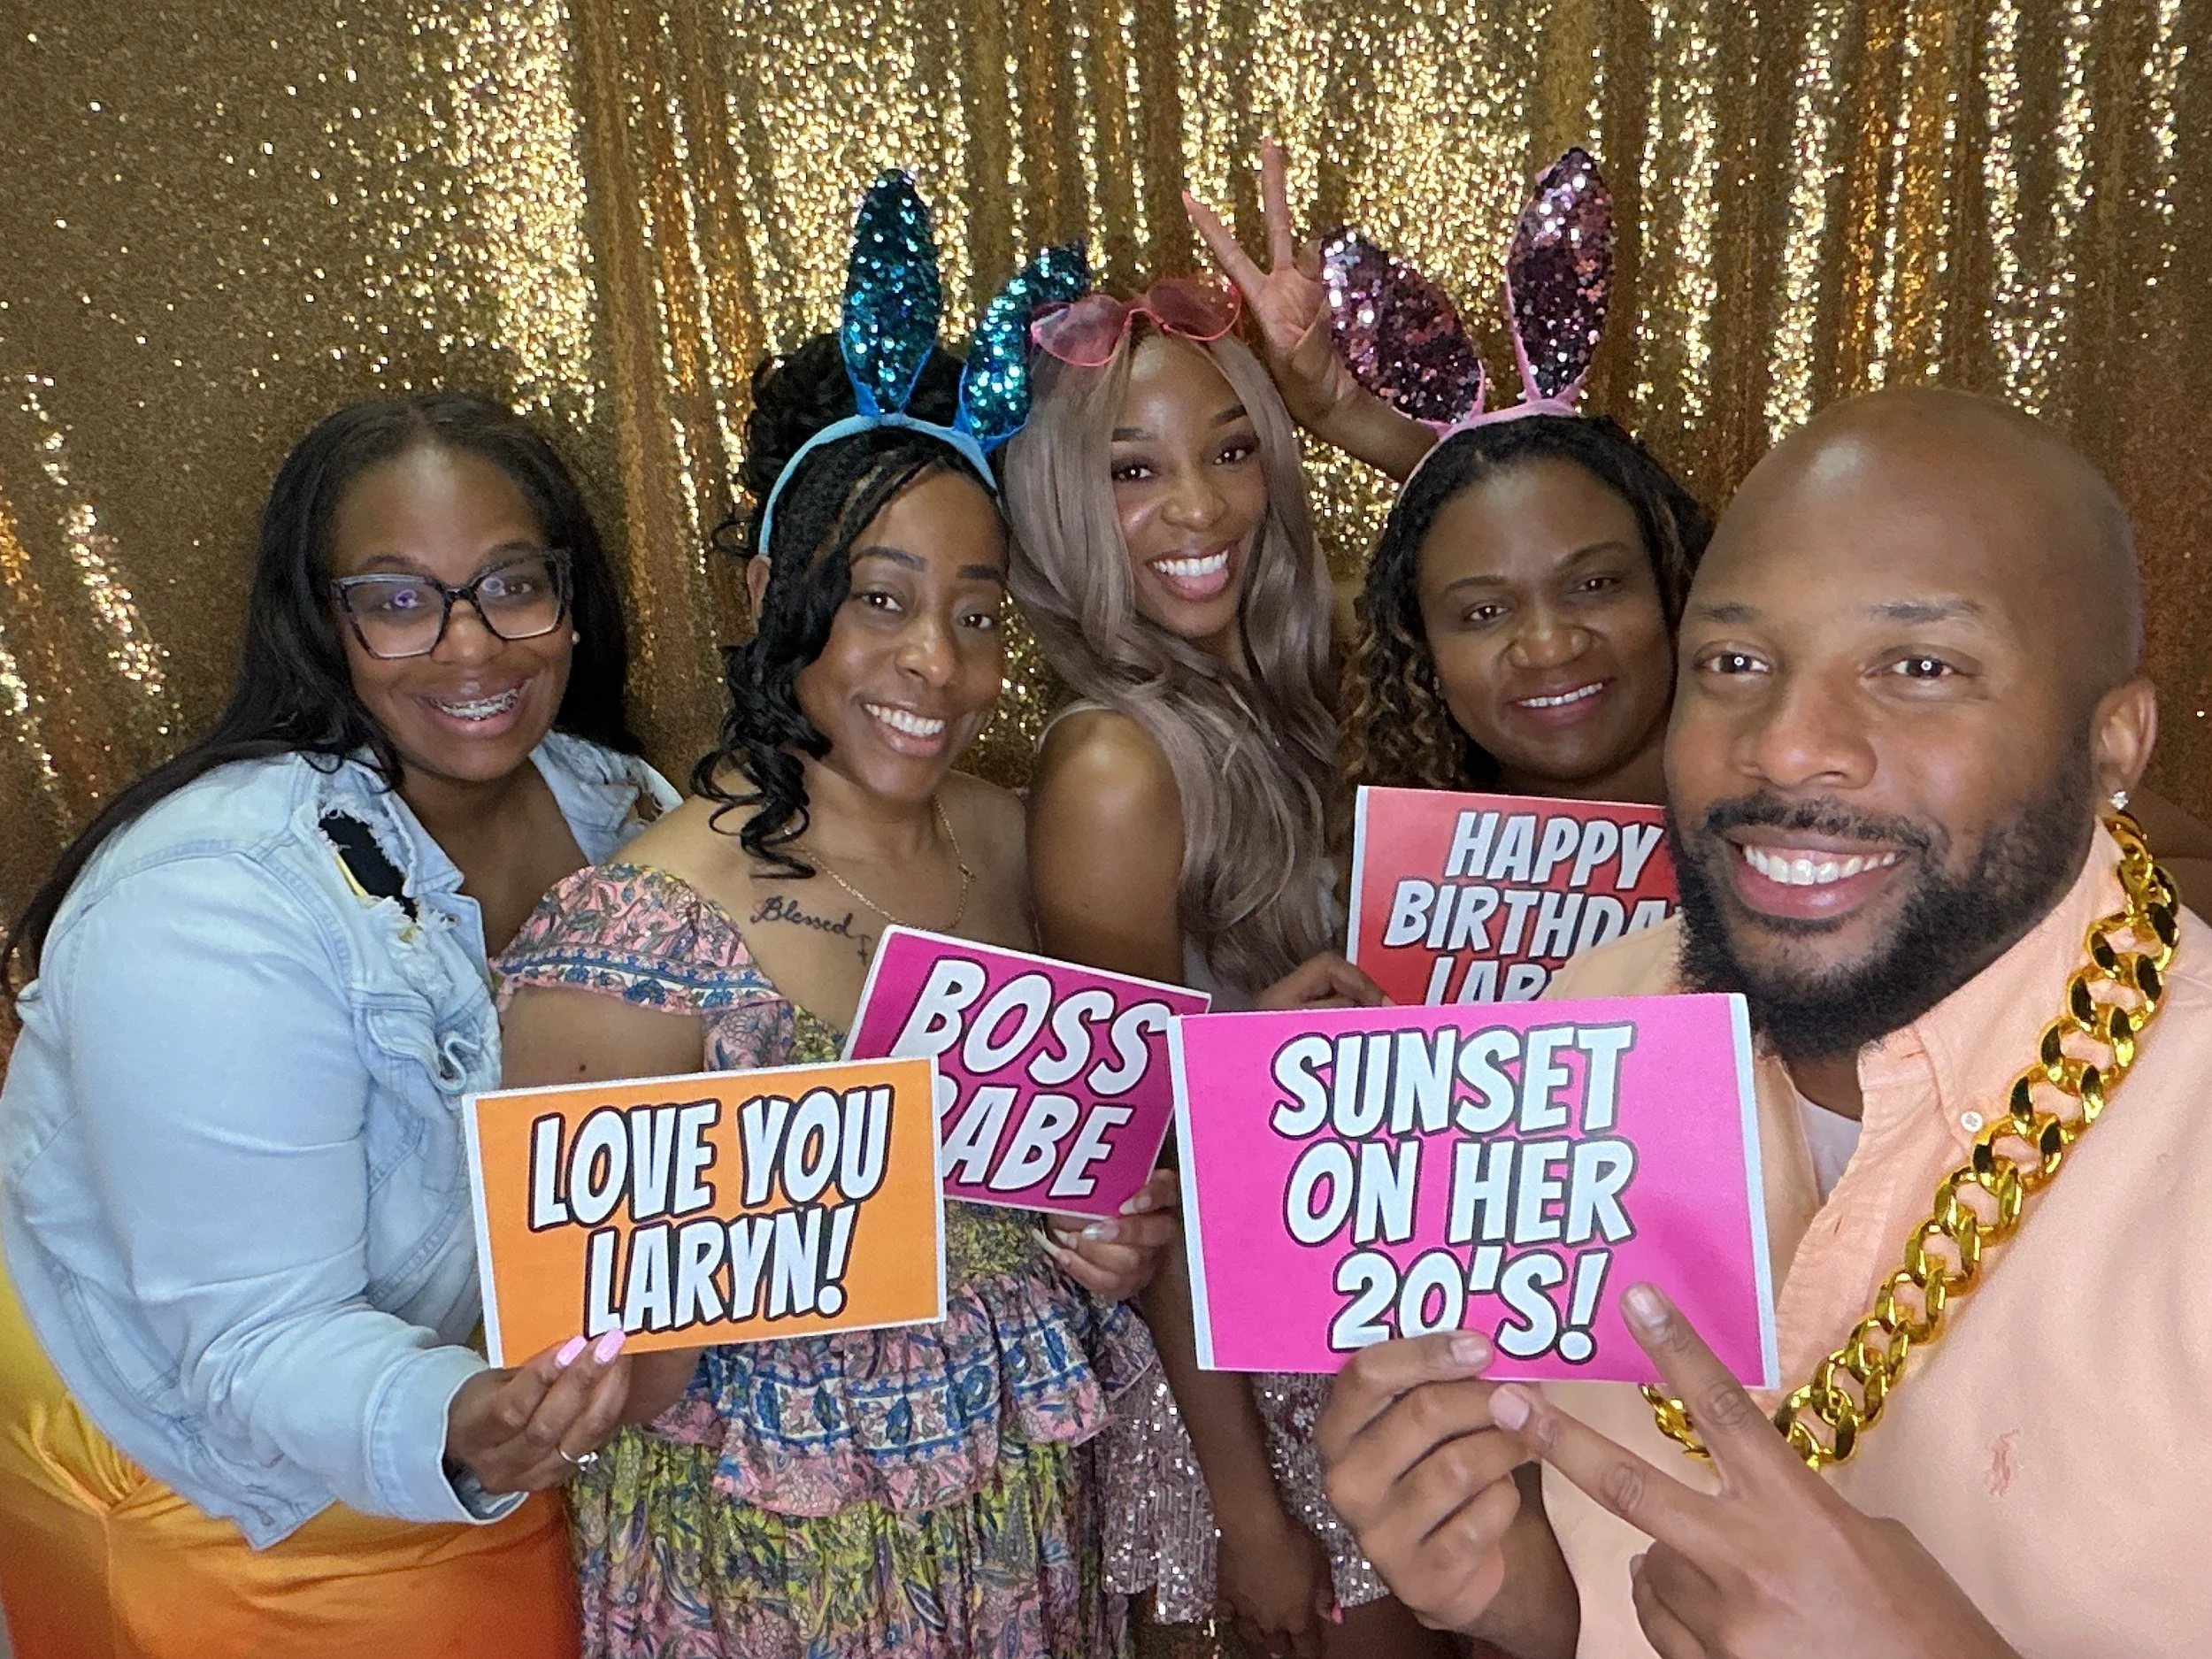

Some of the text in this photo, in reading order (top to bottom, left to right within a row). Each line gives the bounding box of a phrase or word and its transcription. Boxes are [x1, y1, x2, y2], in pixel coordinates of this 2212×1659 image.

[1444, 809, 1667, 890] HAPPY
[750, 895, 872, 939] Blessed
[1382, 878, 1683, 960] BIRTHDA
[888, 956, 1171, 1095] BOSS
[1269, 1023, 1635, 1139] SUNSET
[528, 1084, 895, 1233] LOVE YOU
[1284, 1136, 1637, 1249] ON HER
[583, 1203, 860, 1340] LARYN!
[1326, 1243, 1610, 1364] 20'S!
